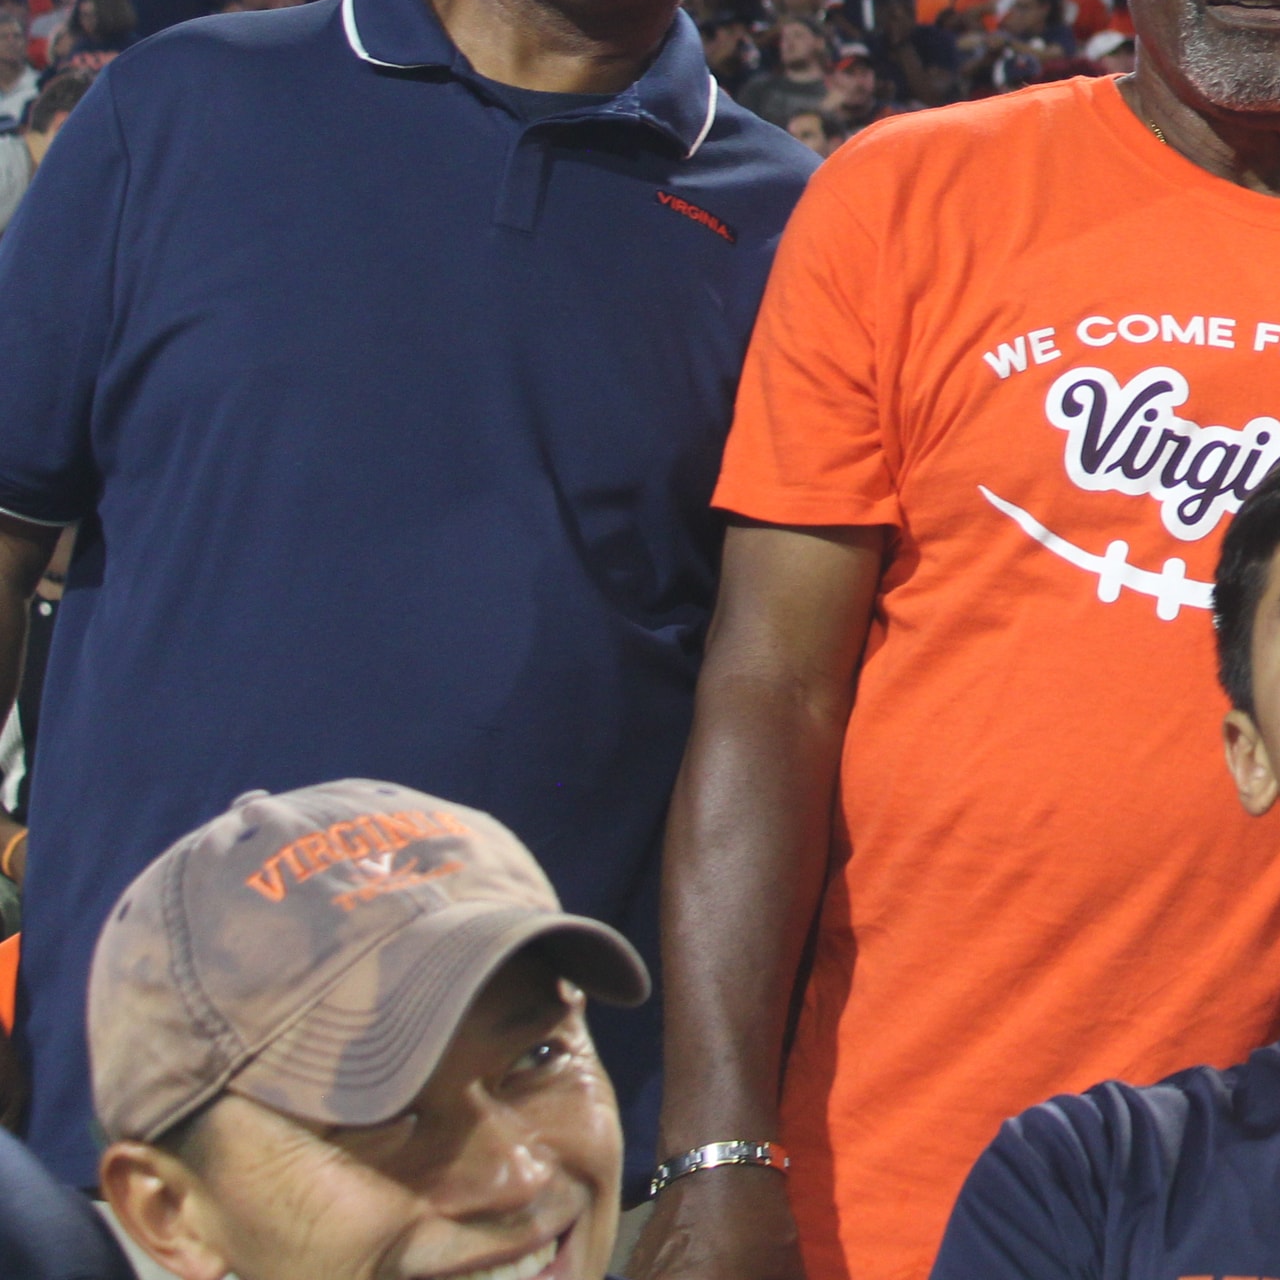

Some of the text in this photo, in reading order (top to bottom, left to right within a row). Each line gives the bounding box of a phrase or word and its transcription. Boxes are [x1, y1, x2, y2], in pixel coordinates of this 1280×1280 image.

[656, 190, 735, 243] VIRGINIA
[983, 327, 1062, 380] WE
[1076, 314, 1236, 349] COME
[245, 811, 477, 902] VIRGINIA
